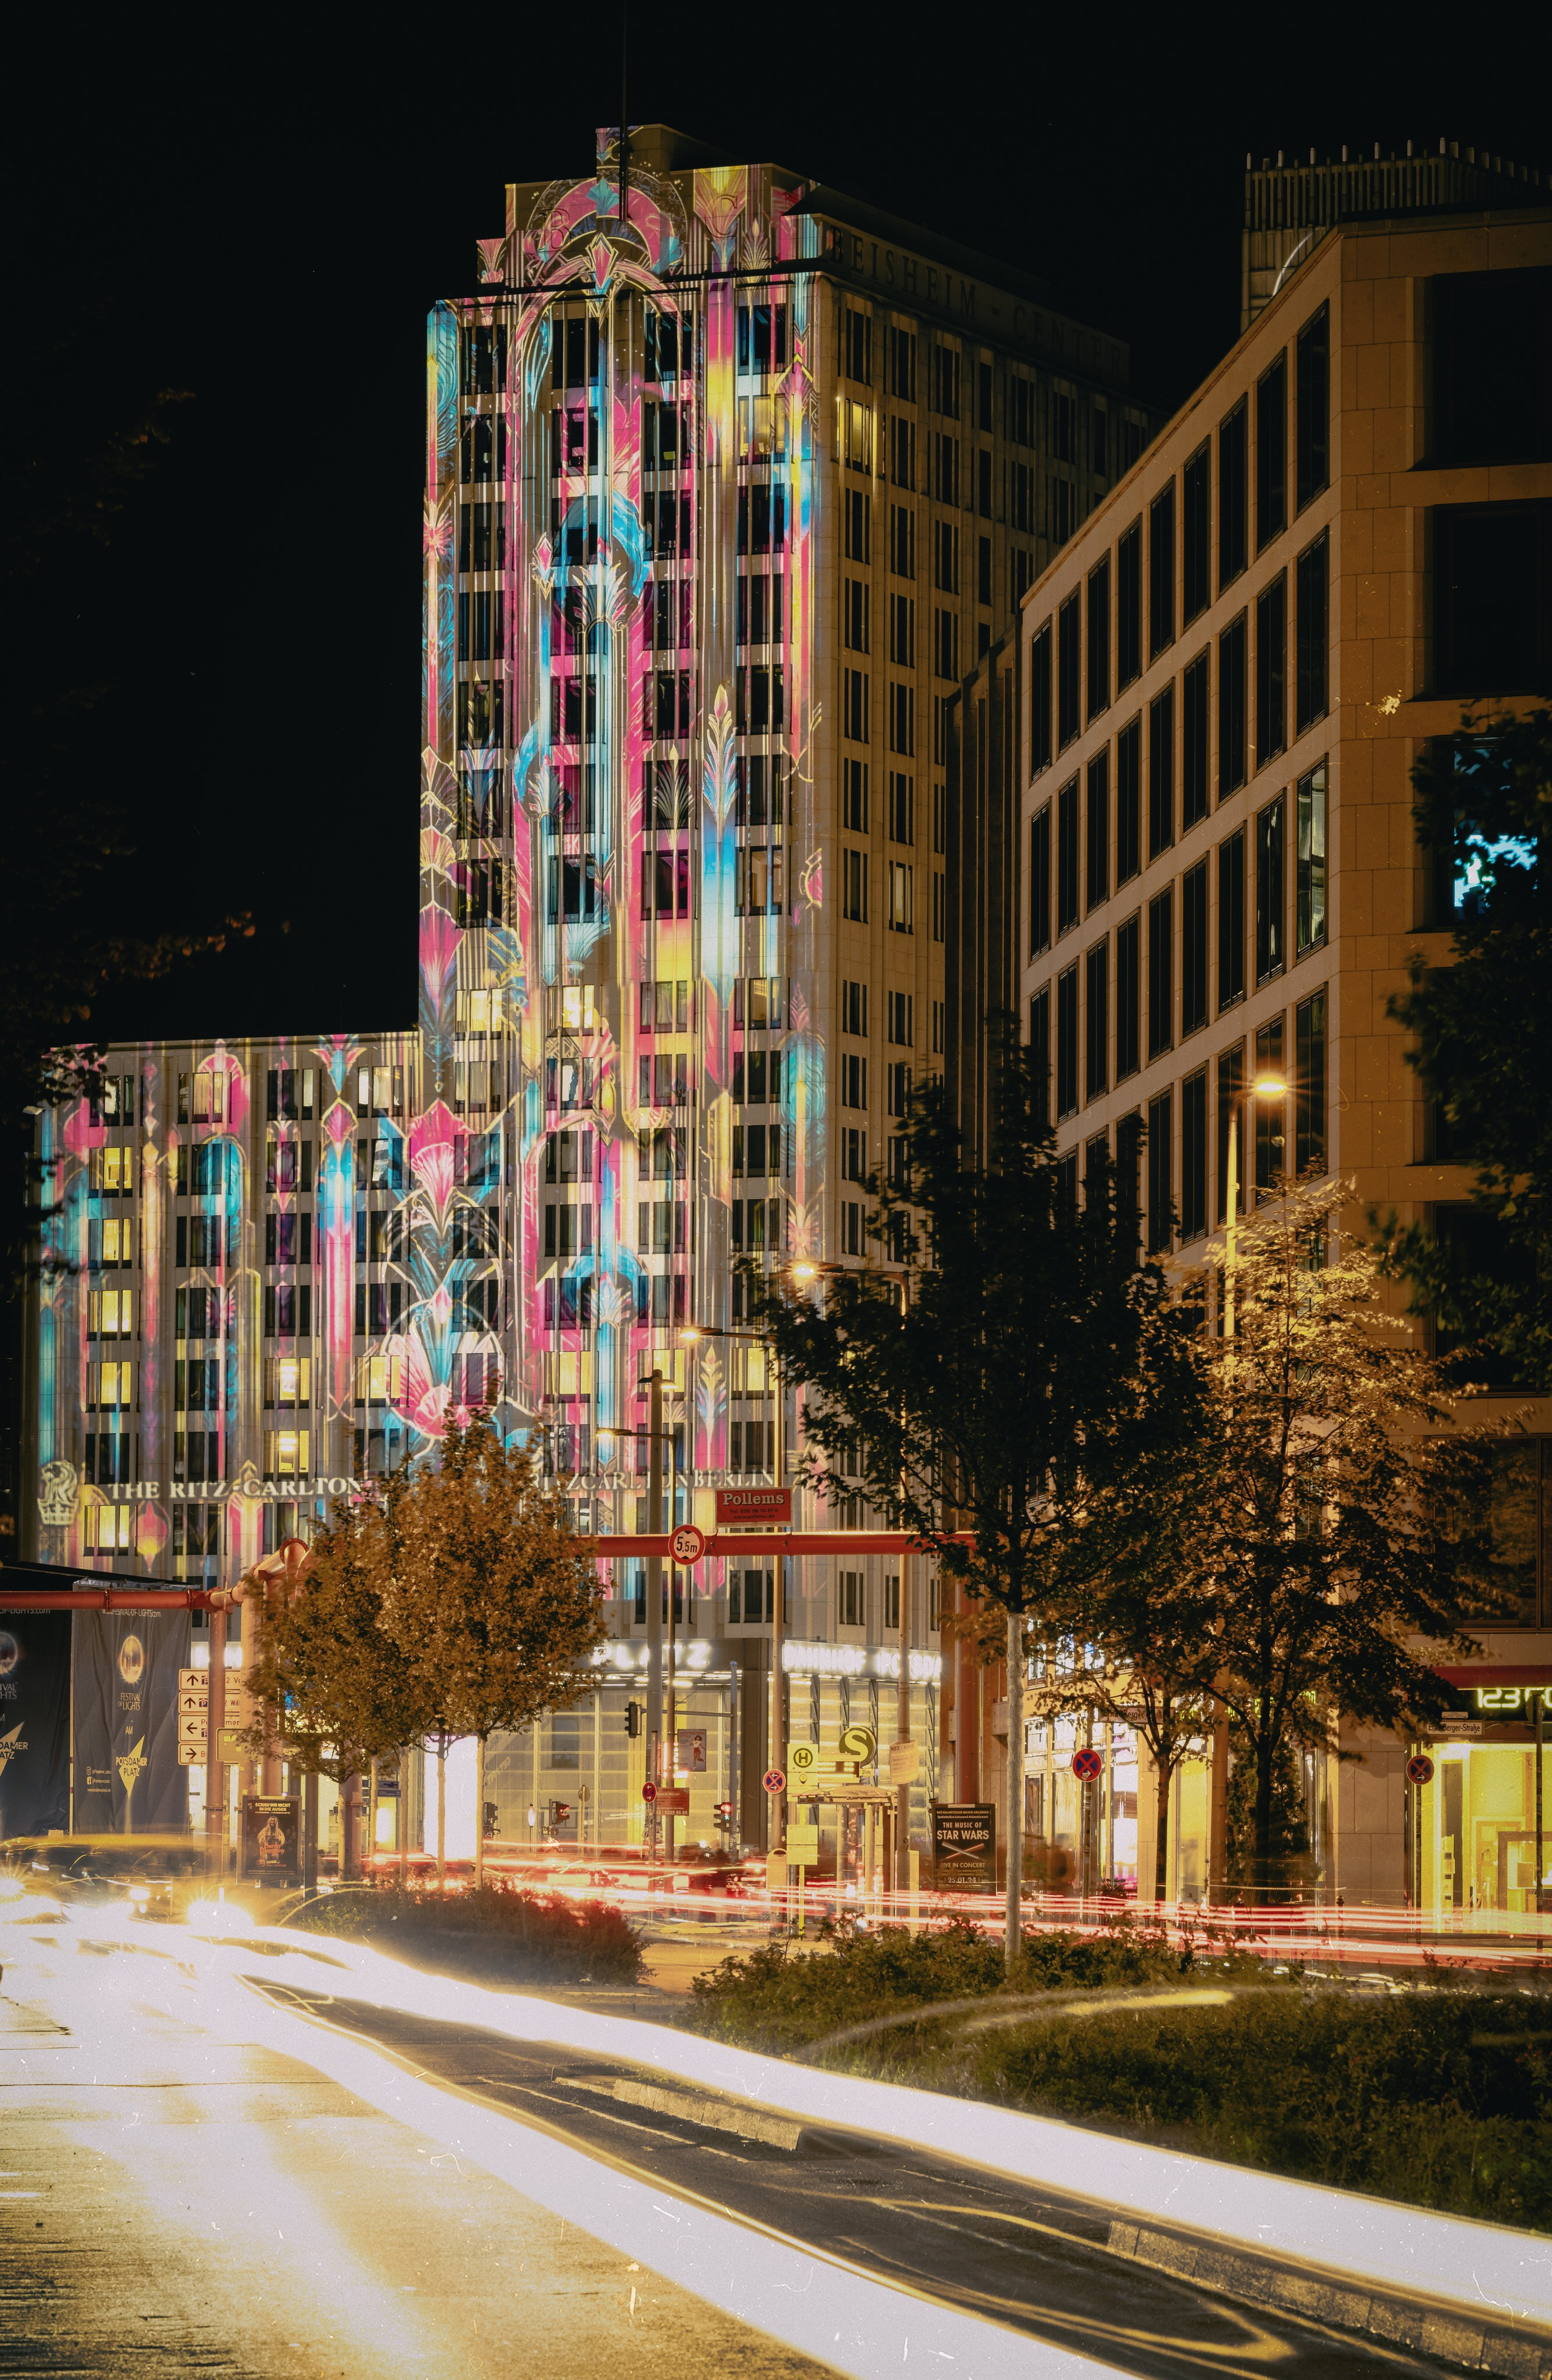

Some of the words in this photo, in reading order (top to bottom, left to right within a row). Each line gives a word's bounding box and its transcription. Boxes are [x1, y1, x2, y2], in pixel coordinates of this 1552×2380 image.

[829, 225, 976, 322] BEISHEIM
[1013, 303, 1123, 381] CENTER
[694, 1467, 775, 1487] BERLIN
[108, 1481, 159, 1500] THE
[723, 1493, 784, 1505] Pollems
[1477, 1688, 1520, 1708] 123
[122, 1701, 141, 1711] LIGHTS
[1428, 1723, 1480, 1733] ErBerger-Straße
[116, 1757, 147, 1767] POTSDAMER
[123, 1768, 140, 1777] PLATZ
[937, 1830, 959, 1840] STAR
[961, 1830, 989, 1840] WARS
